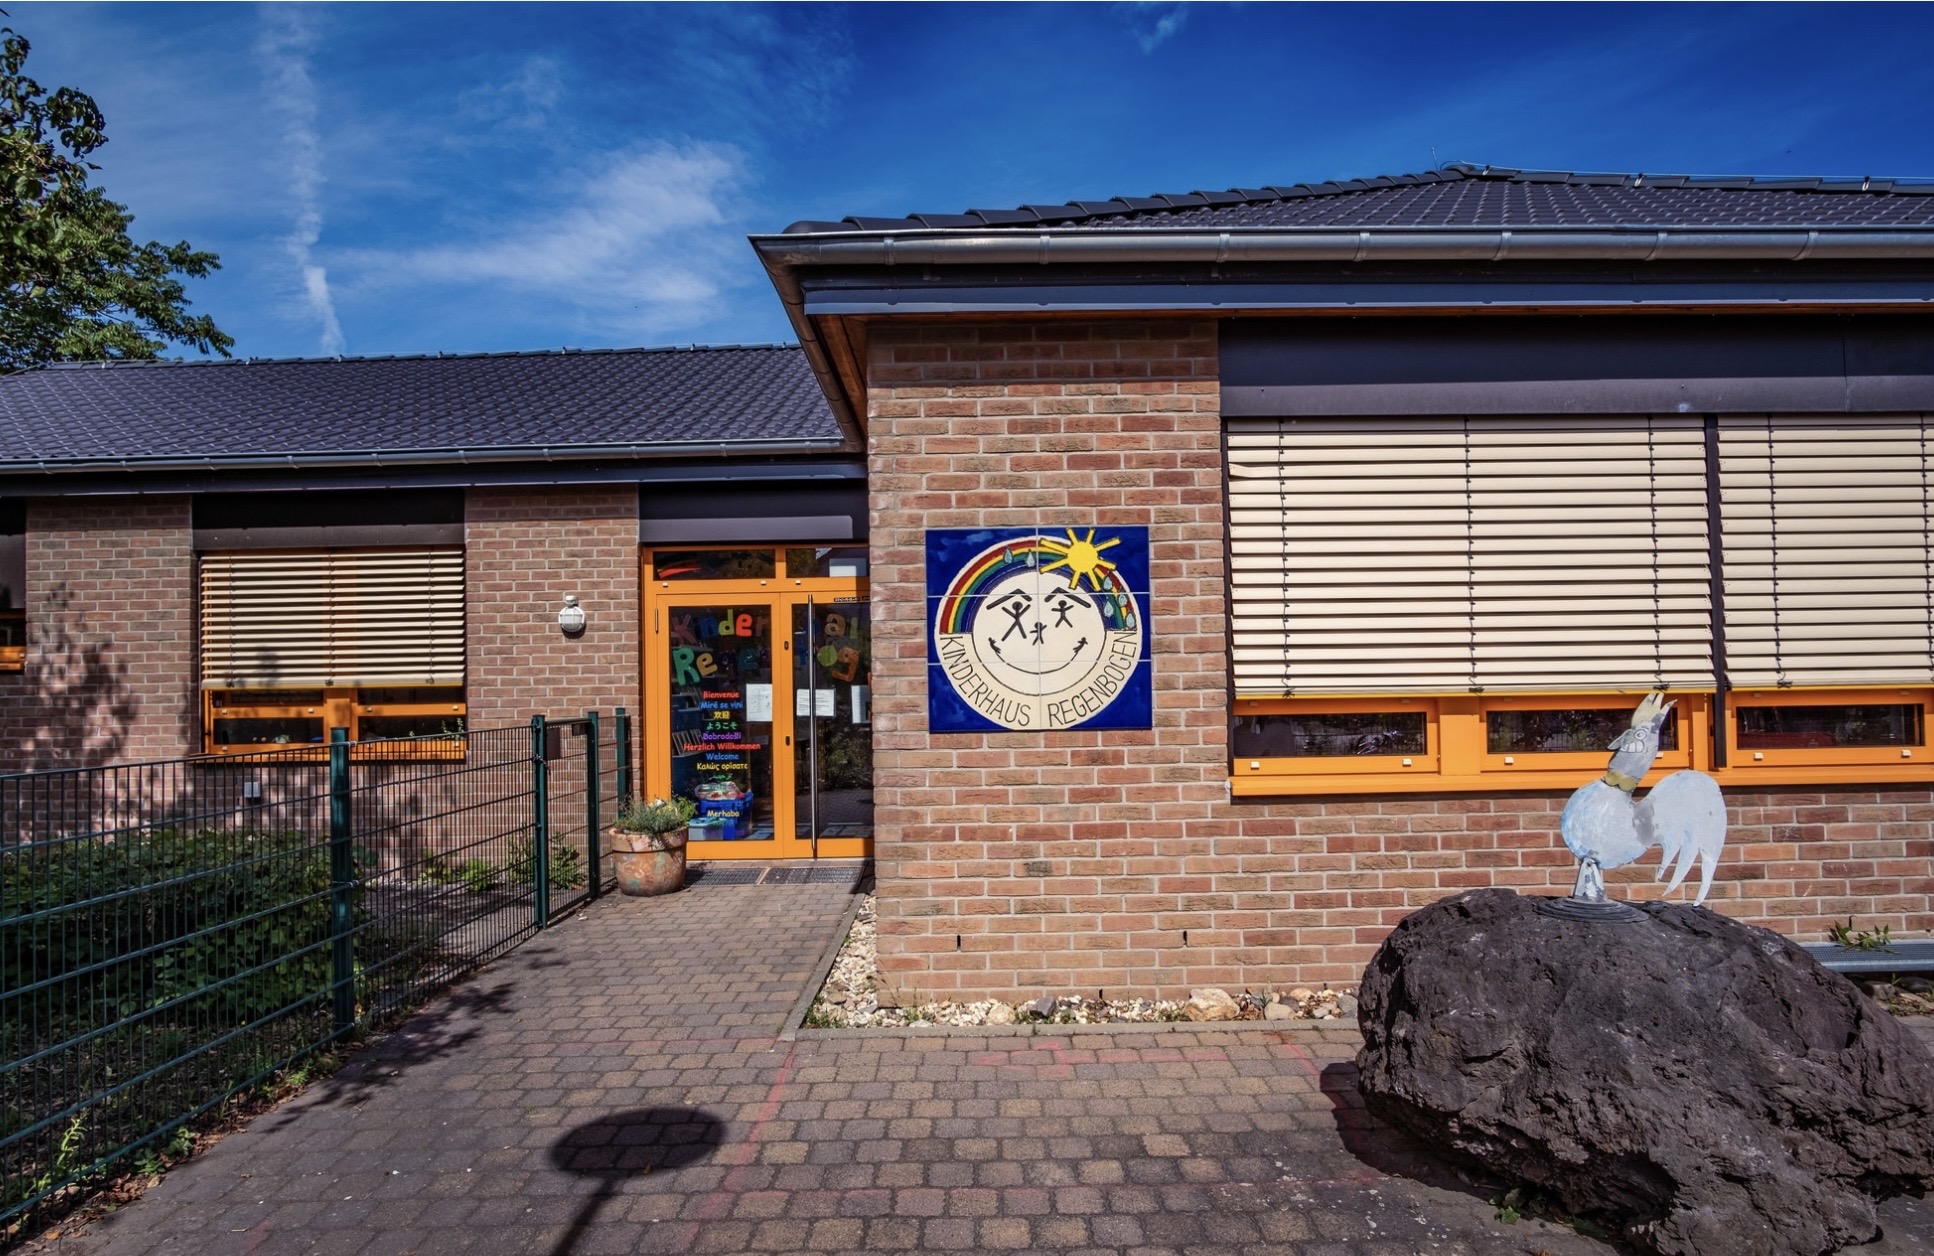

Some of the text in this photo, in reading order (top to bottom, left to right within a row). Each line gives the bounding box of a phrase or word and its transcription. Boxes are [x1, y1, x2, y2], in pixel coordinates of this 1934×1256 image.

[940, 630, 1138, 727] KINDERHAUS REGENBOGEN
[703, 690, 740, 699] Bienvenue
[706, 721, 738, 730] ようこそ
[683, 742, 761, 751] Herzlich Willkommen
[707, 810, 740, 818] Merhaba
